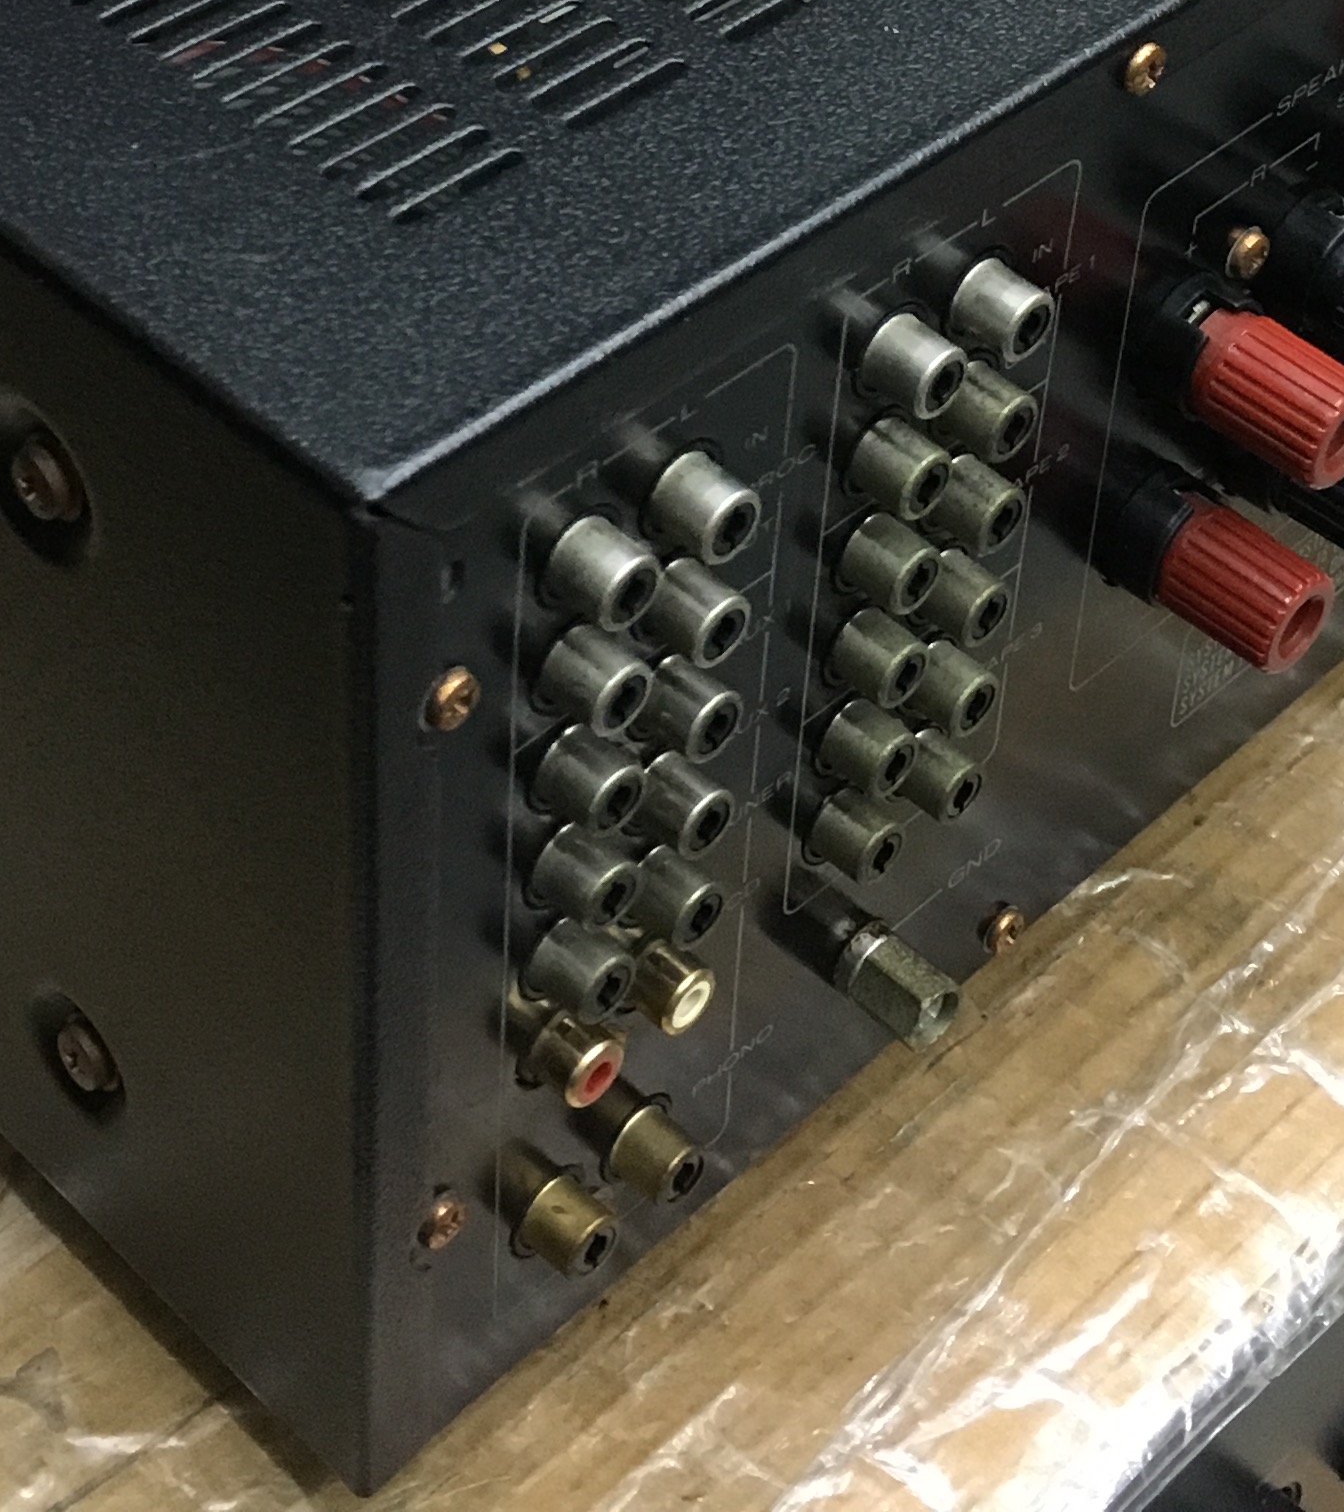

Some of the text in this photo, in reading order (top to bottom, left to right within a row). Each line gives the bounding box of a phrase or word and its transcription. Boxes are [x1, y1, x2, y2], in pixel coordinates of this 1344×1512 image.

[981, 208, 997, 228] L
[1031, 238, 1054, 264] IN
[1045, 263, 1083, 293] PE
[752, 444, 817, 489] ROC
[1014, 443, 1070, 489] APE 2
[987, 634, 1028, 672] APE
[948, 838, 1003, 888] GND
[692, 1024, 774, 1099] PHONO
